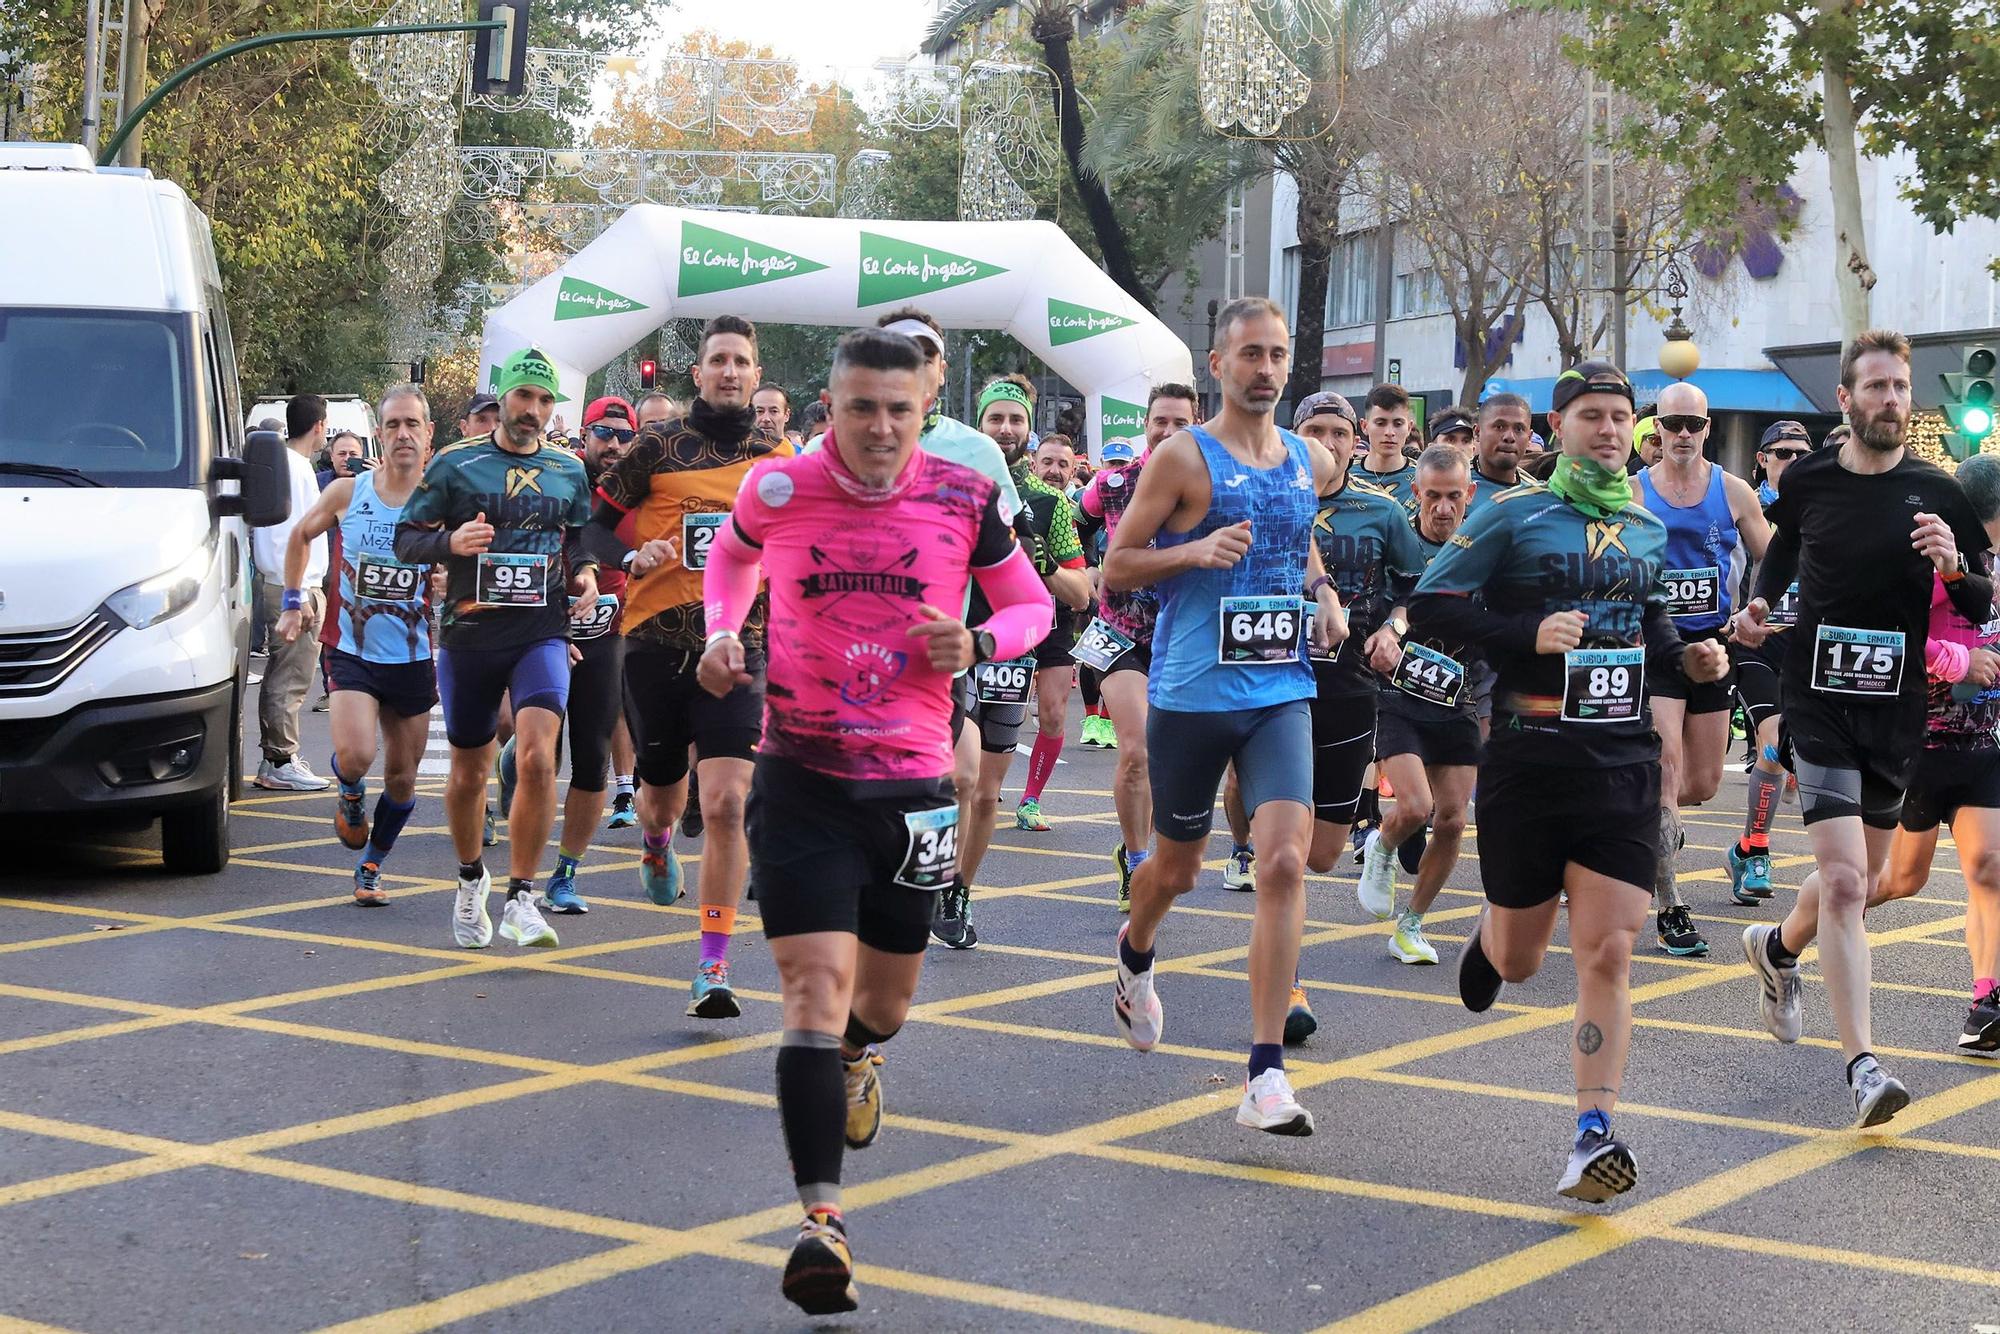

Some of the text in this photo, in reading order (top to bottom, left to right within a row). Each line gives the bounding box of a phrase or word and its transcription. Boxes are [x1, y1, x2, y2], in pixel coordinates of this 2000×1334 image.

[683, 246, 798, 277] El Corte Inglés
[863, 254, 978, 283] El Corte Inglés
[560, 290, 631, 311] El Corte Inglés
[1050, 312, 1122, 330] El Corte Inglés
[1103, 413, 1112, 426] El
[1112, 414, 1136, 426] Corte
[506, 466, 543, 500] IX
[694, 527, 721, 551] 2
[1585, 519, 1630, 563] IX
[363, 565, 414, 588] 570
[495, 566, 532, 589] 95
[817, 574, 908, 593] SATYSTRAIL
[1665, 580, 1713, 601] 305
[1233, 601, 1261, 611] SUBIDA
[1231, 612, 1294, 642] 646
[1829, 630, 1901, 645] SUBIDA ERMITAS
[1083, 629, 1121, 657] 362
[1578, 655, 1608, 665] SUBIDA
[1617, 653, 1642, 664] ERMITAS
[1828, 643, 1894, 673] 175
[982, 666, 1026, 688] 406
[1405, 658, 1456, 688] 447
[1589, 667, 1629, 697] 89
